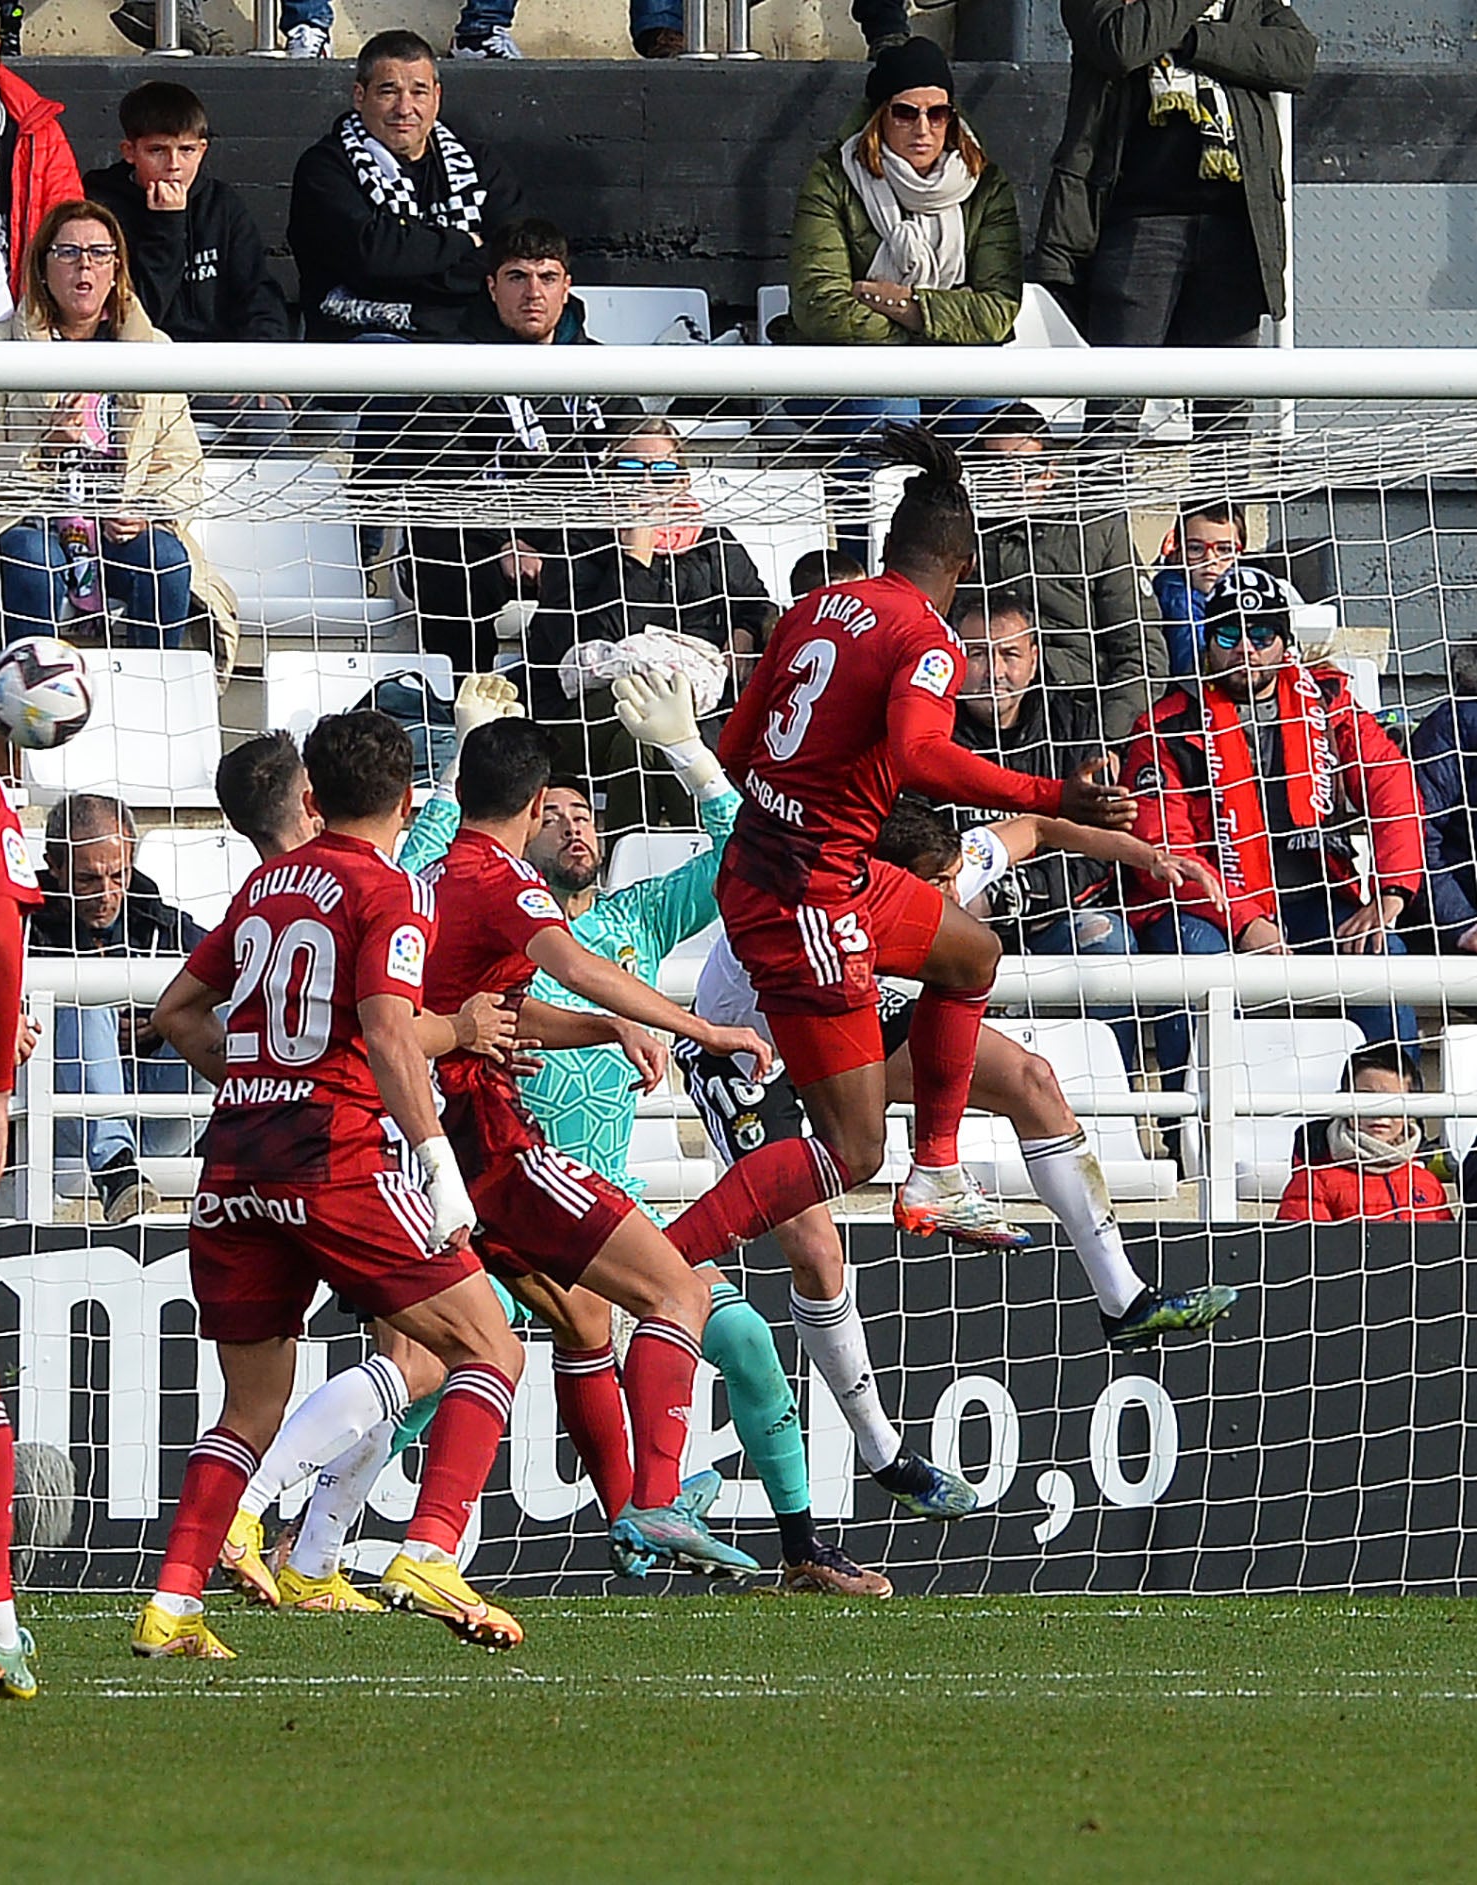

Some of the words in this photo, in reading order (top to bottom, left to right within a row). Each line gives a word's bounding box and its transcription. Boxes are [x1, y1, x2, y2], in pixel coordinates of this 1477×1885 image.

[812, 593, 862, 625] JAIR
[112, 662, 122, 674] 3
[347, 658, 358, 669] 5
[764, 638, 836, 761] 3
[690, 842, 700, 854] 7
[248, 864, 344, 915] GIULIANO
[832, 911, 869, 953] 3
[225, 915, 336, 1066] 20
[1023, 1031, 1032, 1043] 9
[217, 1077, 315, 1105] AMBAR
[931, 1375, 1179, 1545] 0,0
